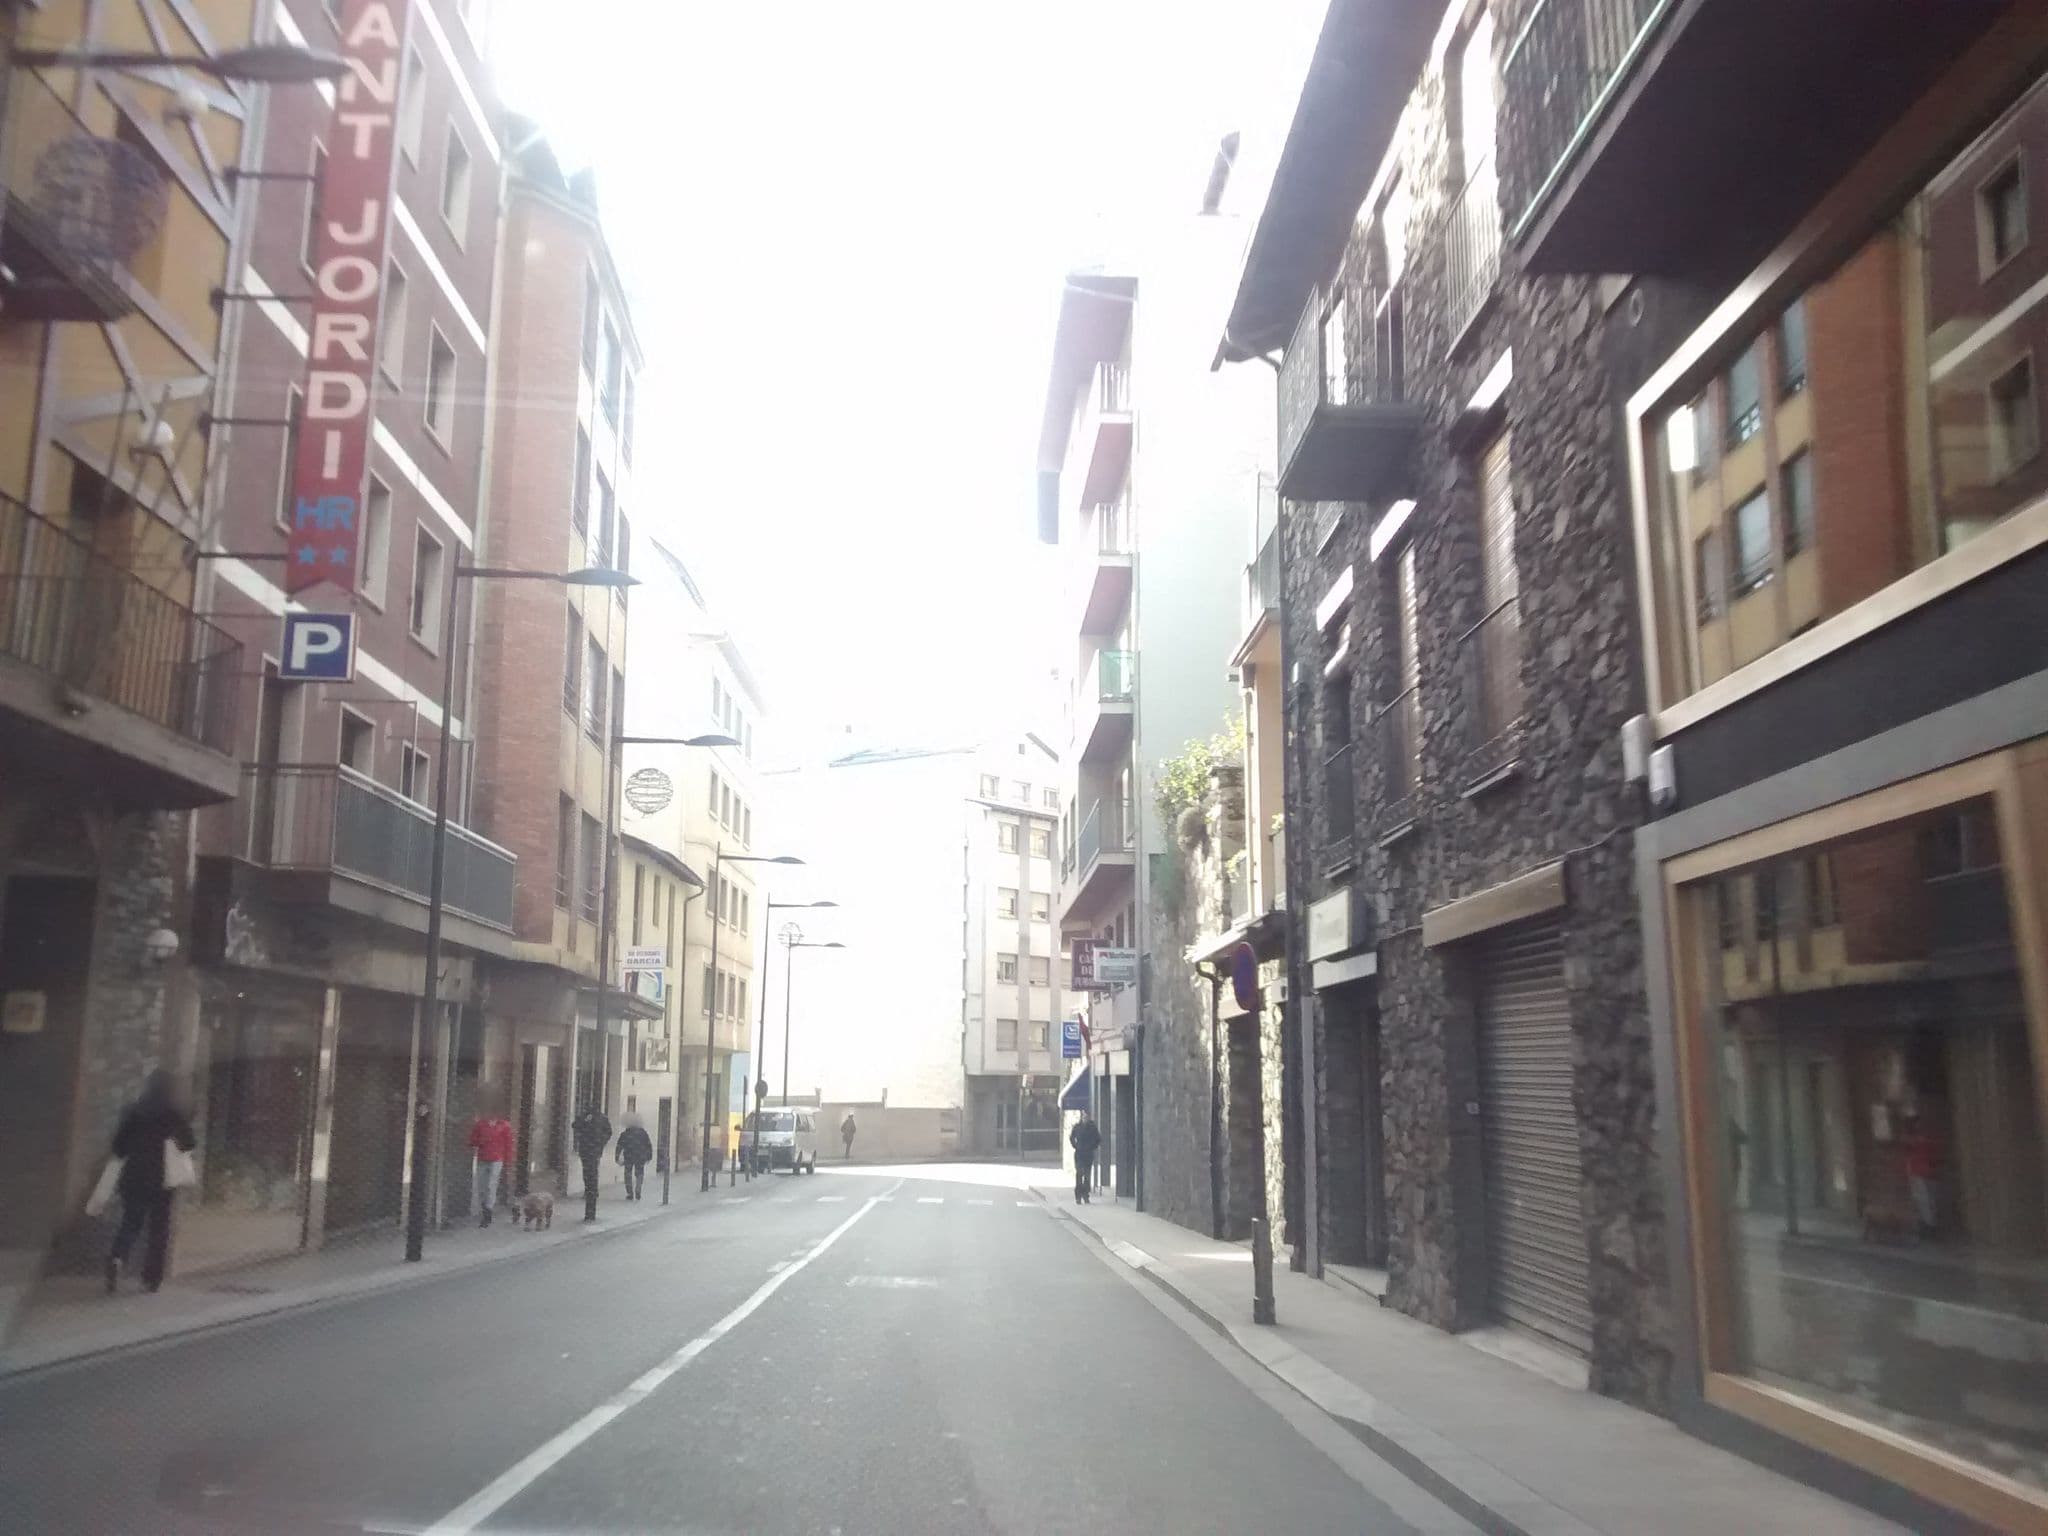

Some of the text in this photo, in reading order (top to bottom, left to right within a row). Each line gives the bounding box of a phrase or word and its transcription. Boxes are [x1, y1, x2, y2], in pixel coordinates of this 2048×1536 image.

[306, 199, 379, 480] JORDI
[296, 497, 356, 530] HR
[290, 622, 342, 670] P
[627, 957, 661, 965] GARCIA
